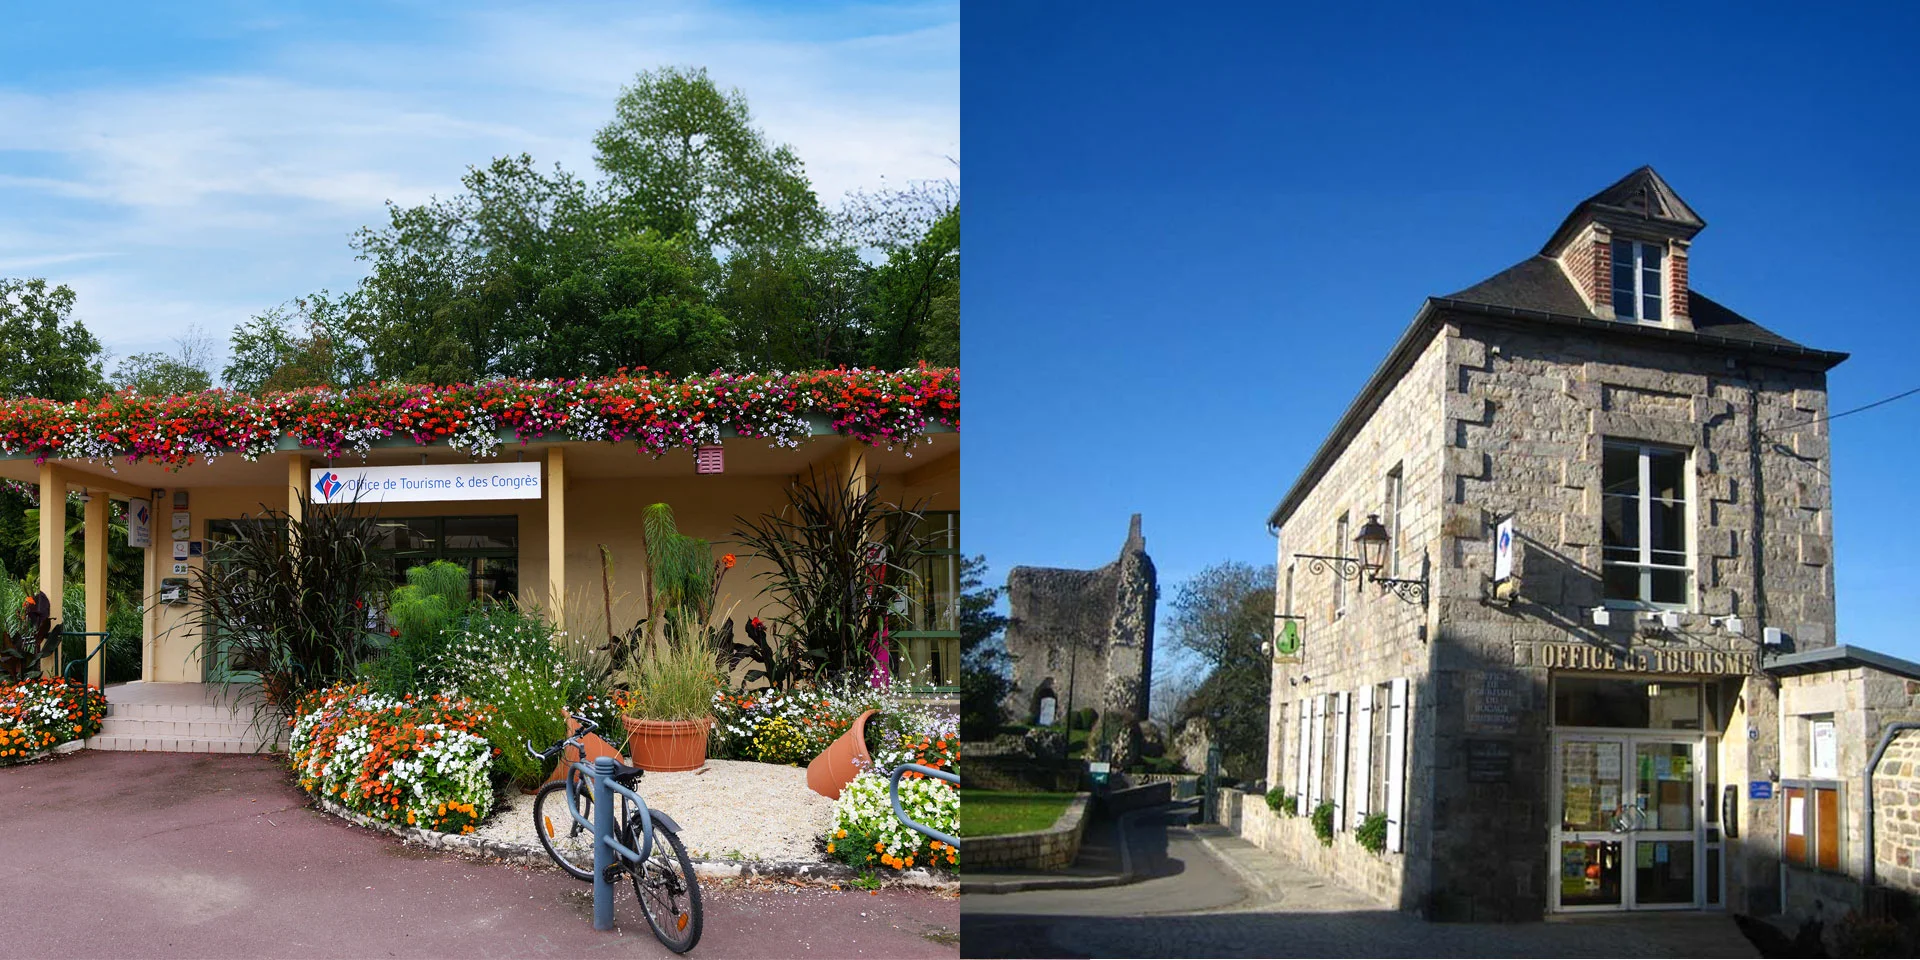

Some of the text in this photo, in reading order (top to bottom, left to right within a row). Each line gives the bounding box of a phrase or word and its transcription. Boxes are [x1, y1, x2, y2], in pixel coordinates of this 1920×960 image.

[383, 478, 397, 490] de
[400, 476, 451, 490] Tourisme
[455, 476, 465, 488] &
[468, 475, 488, 488] des
[491, 474, 538, 490] Congrès
[1542, 644, 1753, 675] OFFICE de TOURISME
